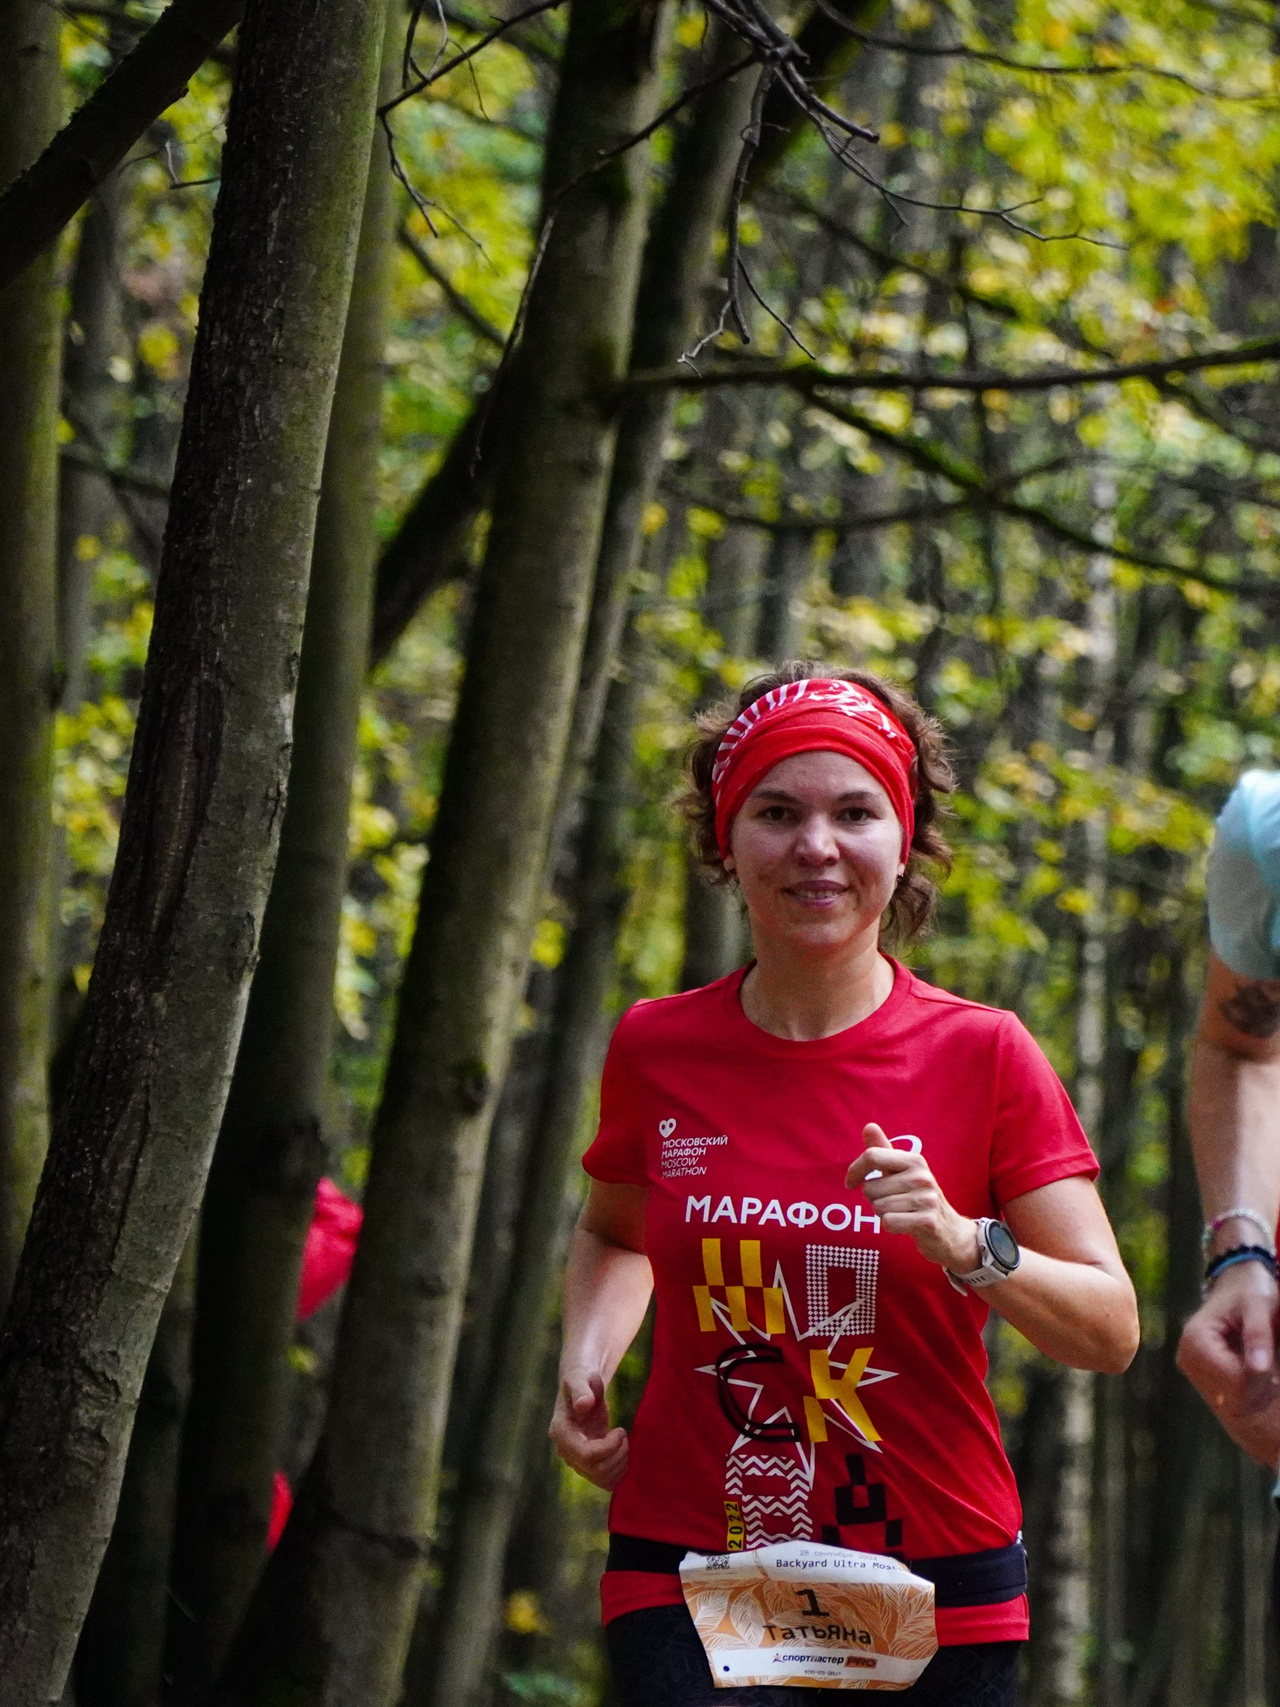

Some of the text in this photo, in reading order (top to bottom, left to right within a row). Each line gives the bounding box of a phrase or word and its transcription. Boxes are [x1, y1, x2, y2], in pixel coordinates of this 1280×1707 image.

[662, 1134, 729, 1149] МОСКОВСКИЙ
[661, 1147, 706, 1159] МАРАФОН
[661, 1157, 699, 1169] MOSCOW
[661, 1167, 707, 1179] MARATHON
[685, 1194, 881, 1235] МАРАФОН
[725, 1502, 743, 1551] 2022
[776, 1559, 828, 1569] Backyard
[833, 1559, 866, 1569] Ultra
[795, 1588, 830, 1618] 1
